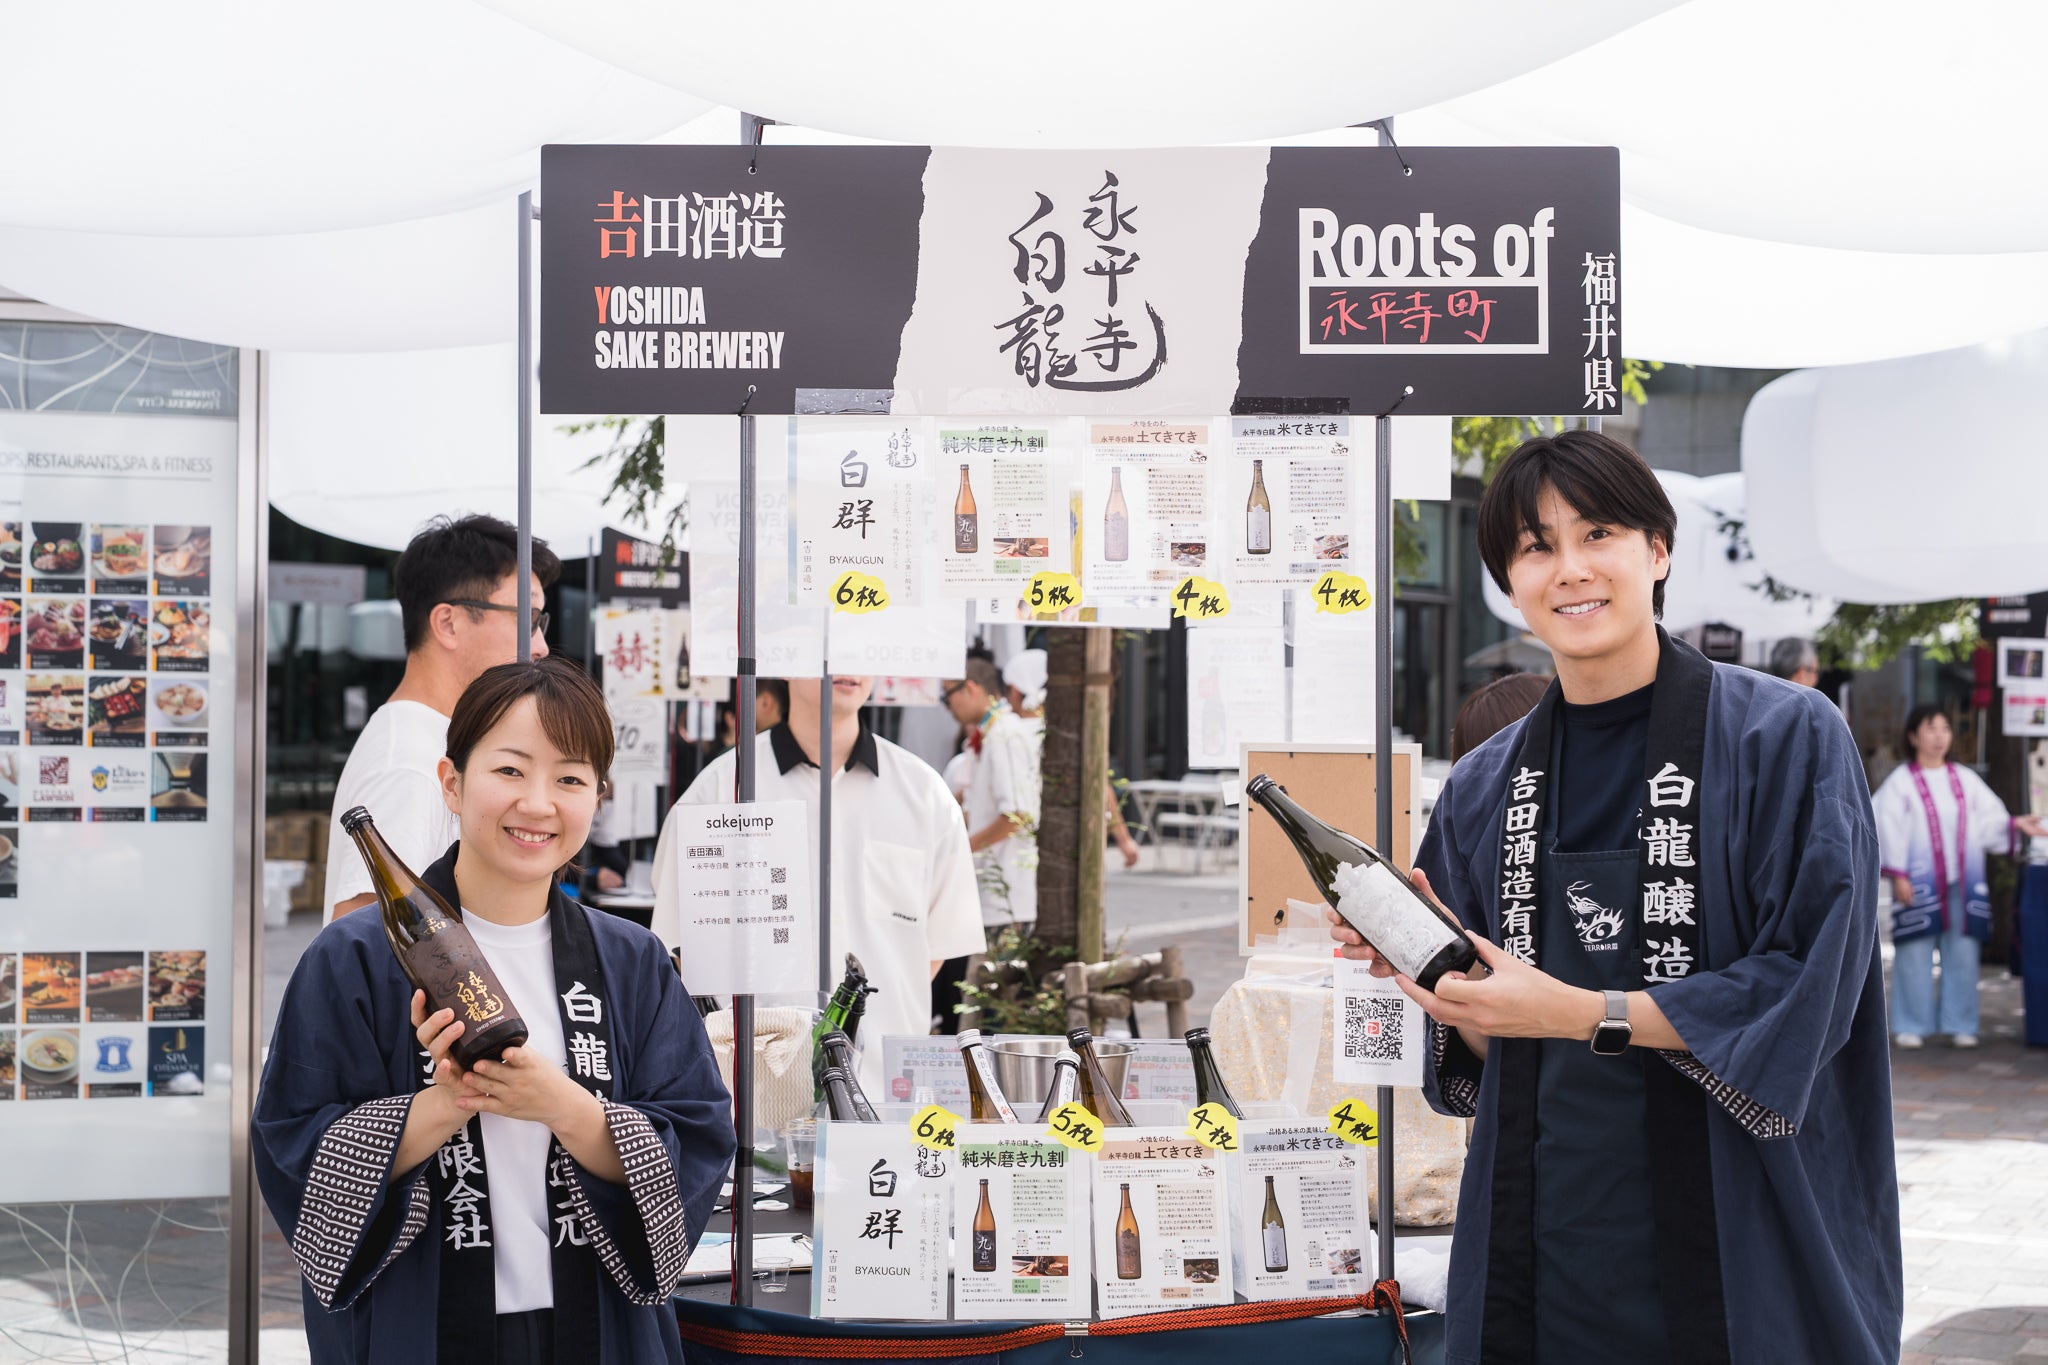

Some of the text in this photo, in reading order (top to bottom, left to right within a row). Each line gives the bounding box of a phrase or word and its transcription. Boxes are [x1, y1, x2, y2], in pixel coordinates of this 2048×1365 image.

[1299, 206, 1555, 277] Roots of
[594, 286, 706, 325] YOSHIDA
[1320, 289, 1497, 344] 永平寺町
[1582, 252, 1617, 410] 福井県
[595, 330, 785, 369] SAKE BREWERY
[1136, 431, 1198, 444] 土てきてき
[1277, 422, 1339, 436] 米てきてき
[942, 436, 1044, 454] 純米磨き九割
[164, 457, 213, 472] FITNESS
[832, 450, 876, 539] 白群
[829, 555, 884, 565] BYAKUGUN
[706, 814, 773, 831] sakejump
[736, 888, 769, 896] 土てきてき
[166, 1053, 188, 1063] SPA
[1143, 1146, 1204, 1159] 土てきてき
[1287, 1137, 1345, 1151] 米てきてき
[962, 1151, 1064, 1168] 純米磨き九割
[858, 1158, 903, 1250] 白群
[855, 1265, 910, 1276] BYAKUGUN
